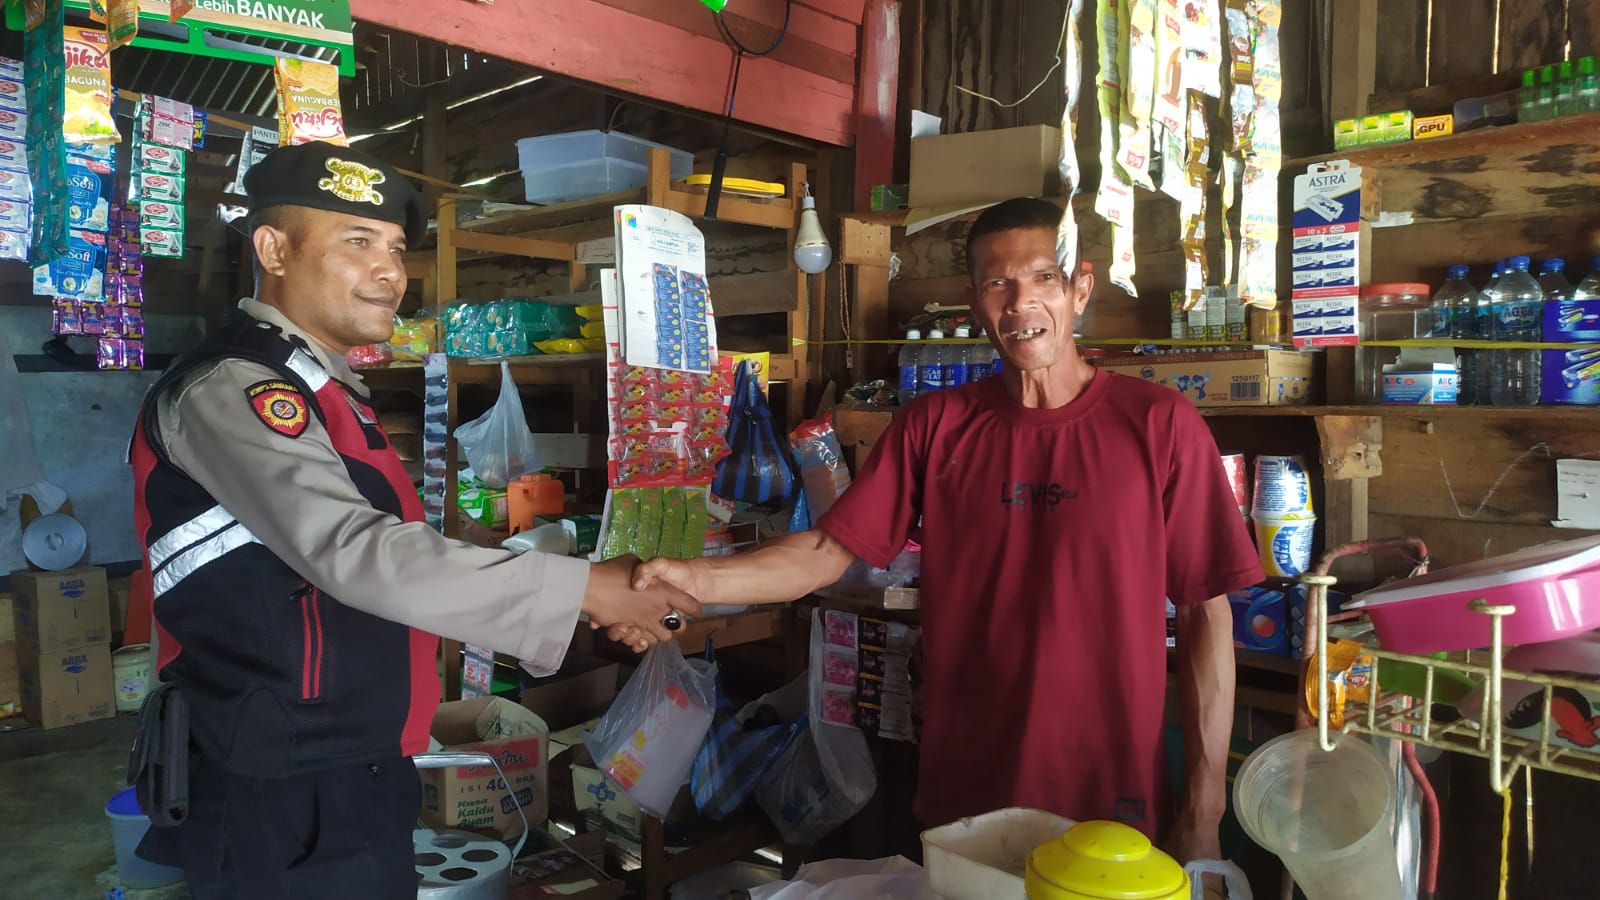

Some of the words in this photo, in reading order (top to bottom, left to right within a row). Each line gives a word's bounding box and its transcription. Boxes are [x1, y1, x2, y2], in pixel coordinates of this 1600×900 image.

[196, 0, 235, 14] Lebih
[237, 0, 326, 29] BANYAK
[64, 45, 109, 70] jiku
[64, 74, 107, 88] BAGUNA
[253, 128, 279, 141] PANTE
[1420, 123, 1446, 134] GPU
[1309, 173, 1346, 188] ASTRA
[1322, 226, 1328, 234] 5
[1504, 306, 1534, 318] AQUA
[1384, 376, 1402, 385] ABC
[1438, 376, 1453, 386] ABC
[486, 776, 508, 792] 40
[457, 798, 488, 808] Rasa
[457, 805, 494, 819] Kaldu
